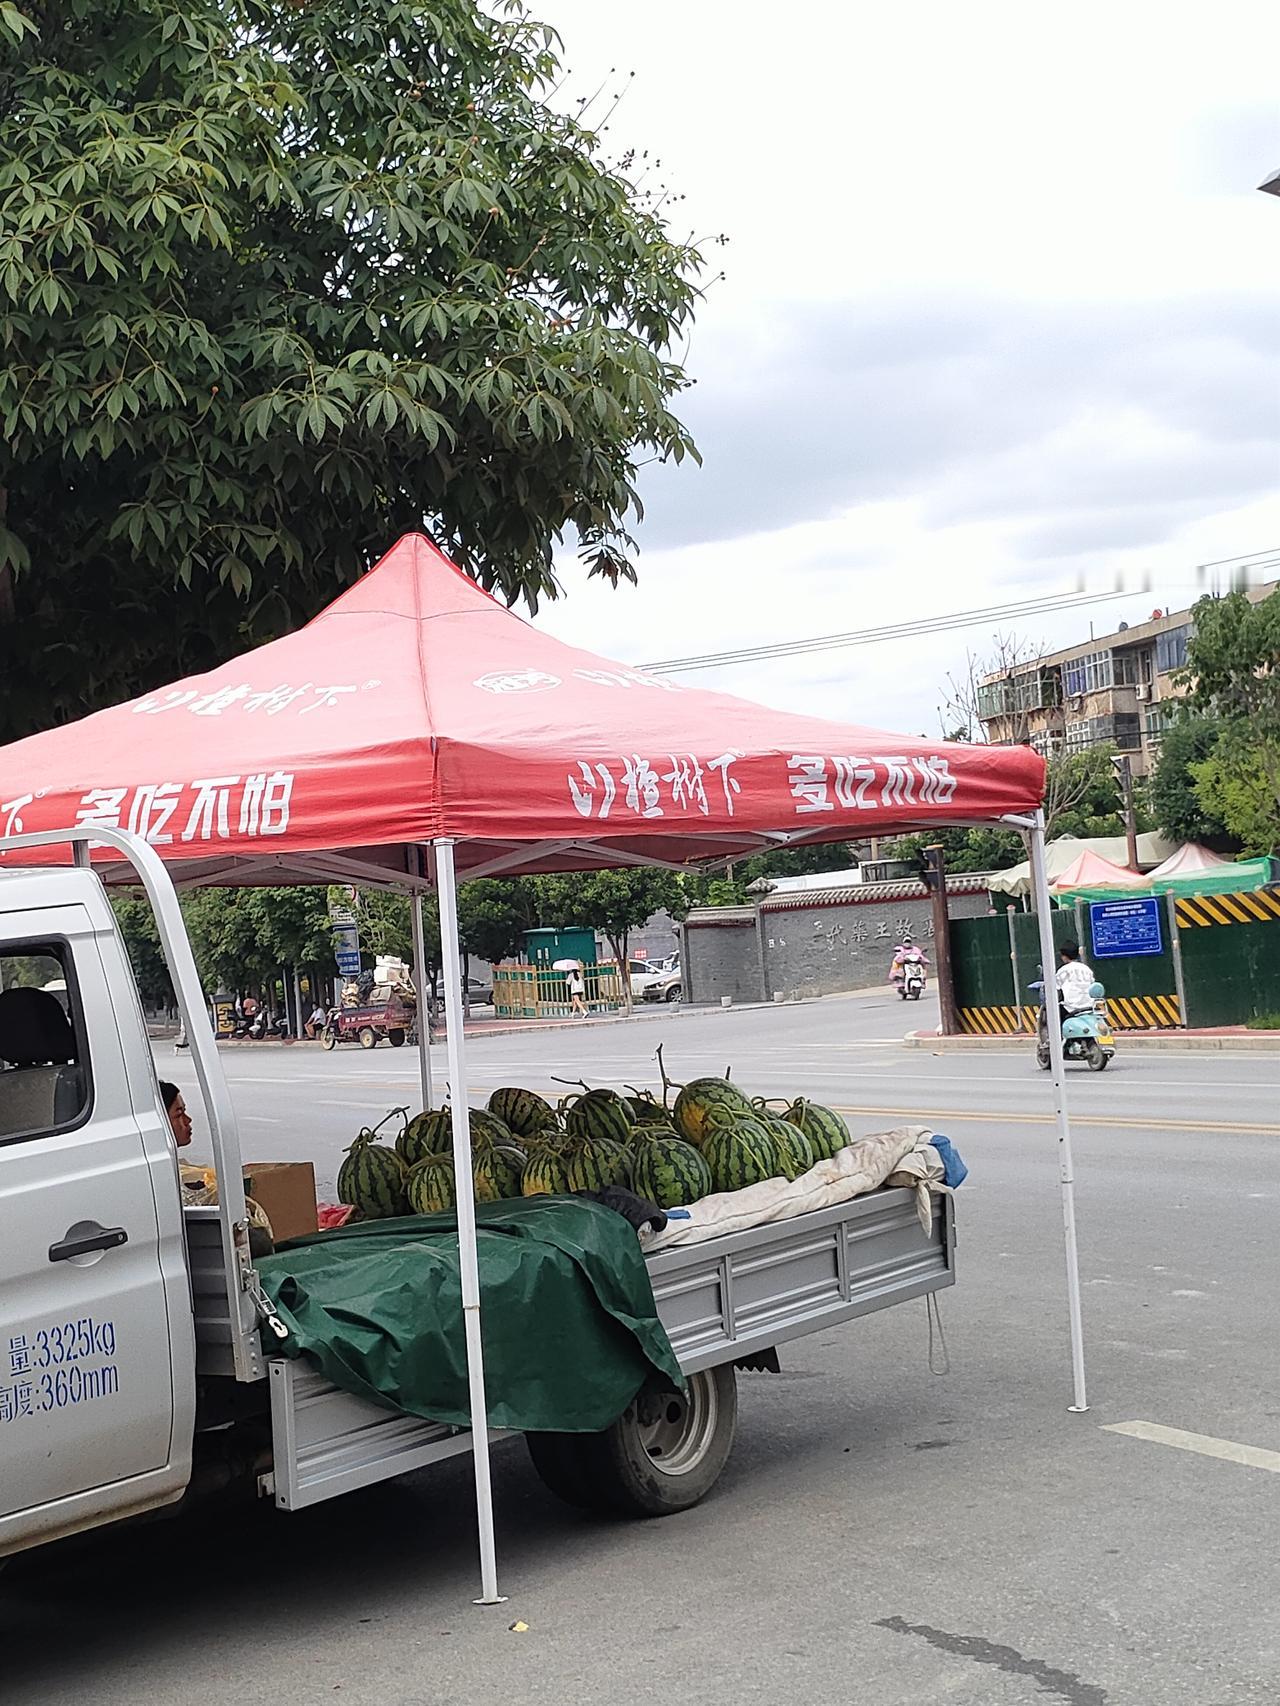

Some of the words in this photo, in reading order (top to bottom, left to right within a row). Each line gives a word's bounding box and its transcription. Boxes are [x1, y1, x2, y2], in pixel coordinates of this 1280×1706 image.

[74, 770, 295, 850] 多吃不怕
[567, 752, 741, 818] 山楂树下
[786, 755, 957, 813] 多吃不怕
